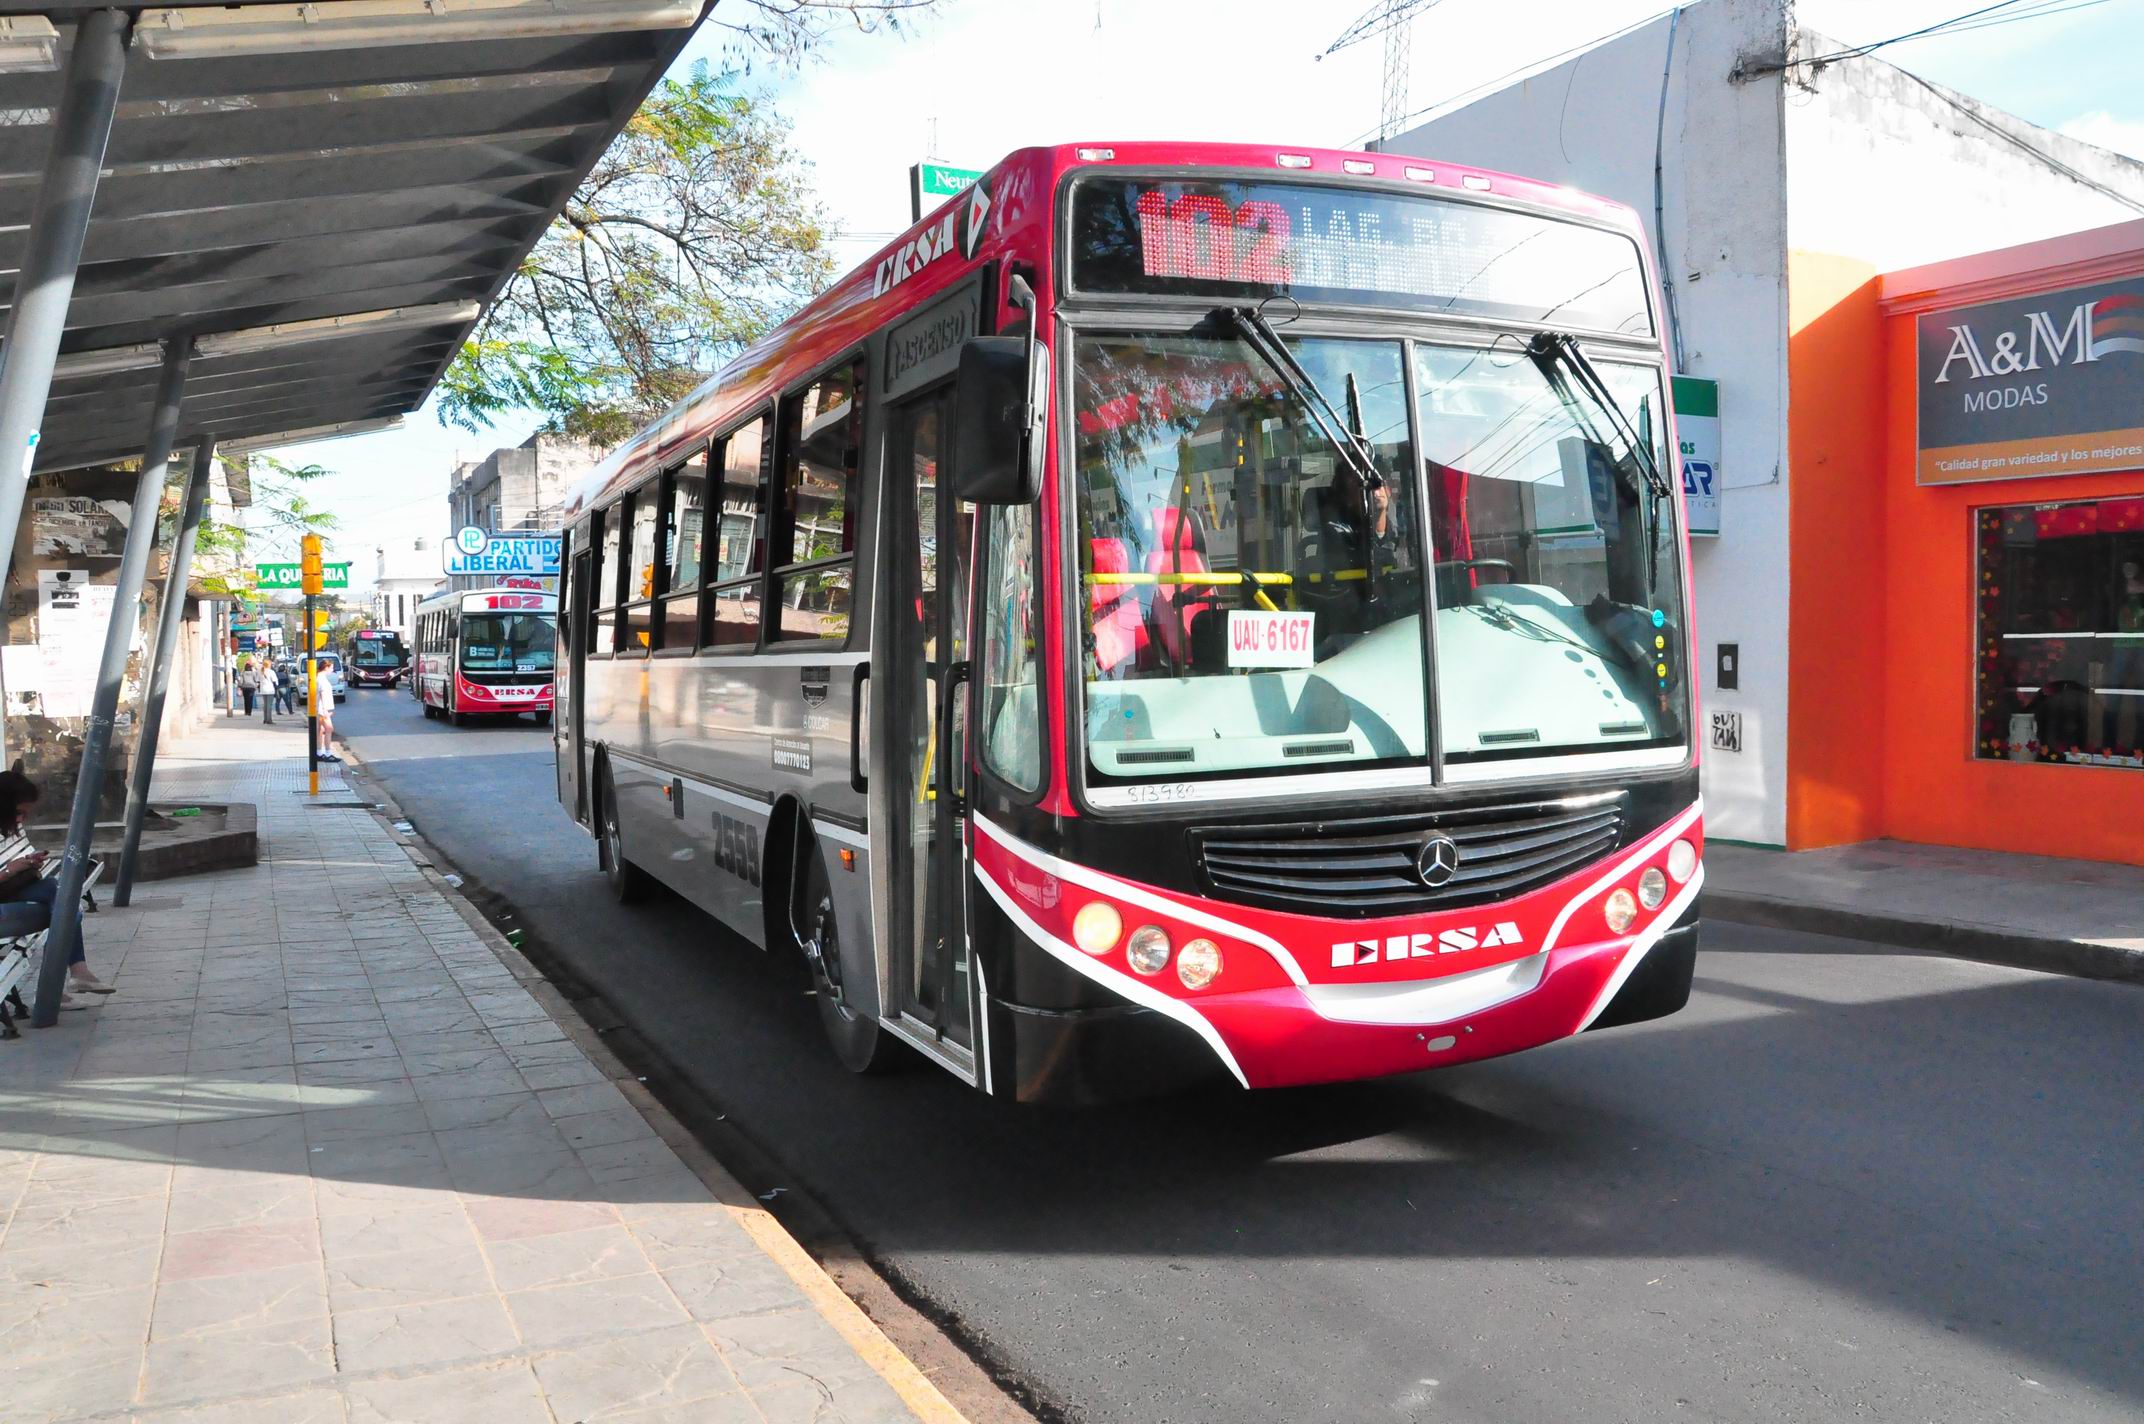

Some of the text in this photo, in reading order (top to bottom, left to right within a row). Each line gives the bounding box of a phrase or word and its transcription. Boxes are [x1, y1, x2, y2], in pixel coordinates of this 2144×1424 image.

[1136, 191, 1292, 283] 102
[897, 310, 966, 373] ASCENSO
[1934, 301, 2101, 384] A&M
[1964, 383, 2049, 413] MODAS
[1981, 457, 2006, 471] gran
[2008, 451, 2058, 466] variedad
[2061, 452, 2068, 463] y
[2071, 448, 2088, 460] los
[2091, 444, 2143, 460] mejores
[257, 568, 277, 582] LA
[451, 555, 534, 571] LIBERAL
[485, 595, 543, 609] 102
[469, 646, 478, 657] B
[1330, 920, 1524, 968] ERSA
